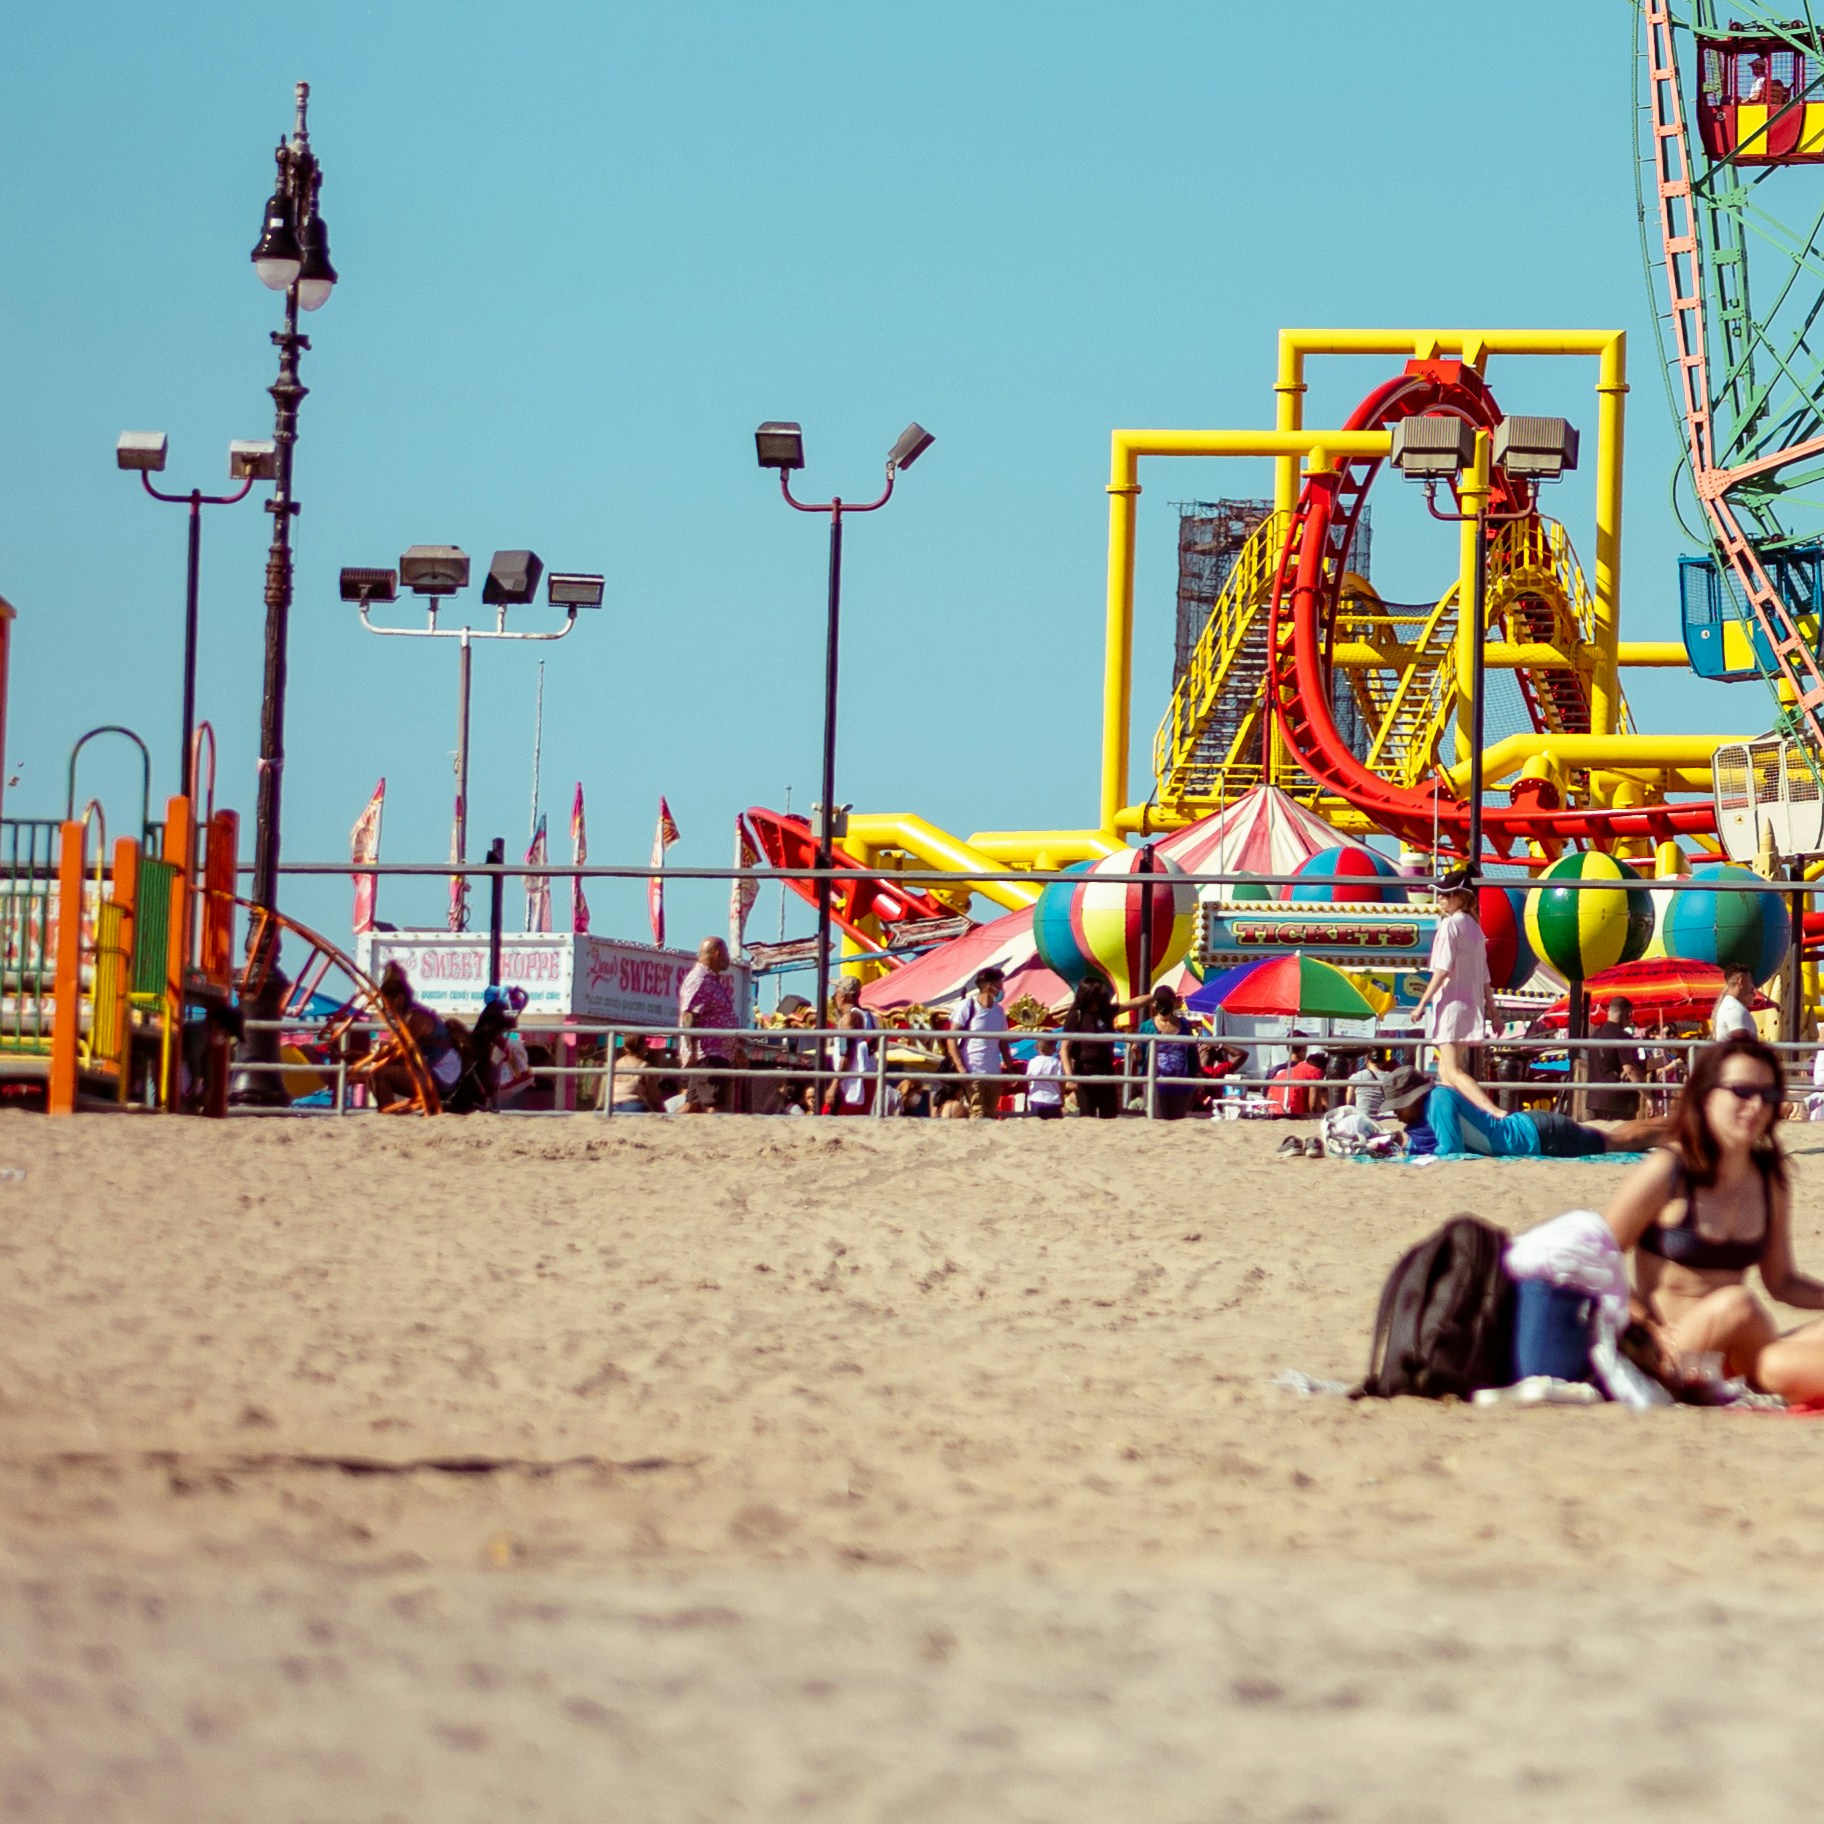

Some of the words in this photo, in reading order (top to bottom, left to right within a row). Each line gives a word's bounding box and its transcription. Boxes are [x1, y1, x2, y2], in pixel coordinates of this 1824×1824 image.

[1235, 922, 1418, 947] TICKETS
[419, 950, 486, 981] SWEET
[499, 950, 561, 982] HOPPE
[619, 957, 673, 998] SWEET
